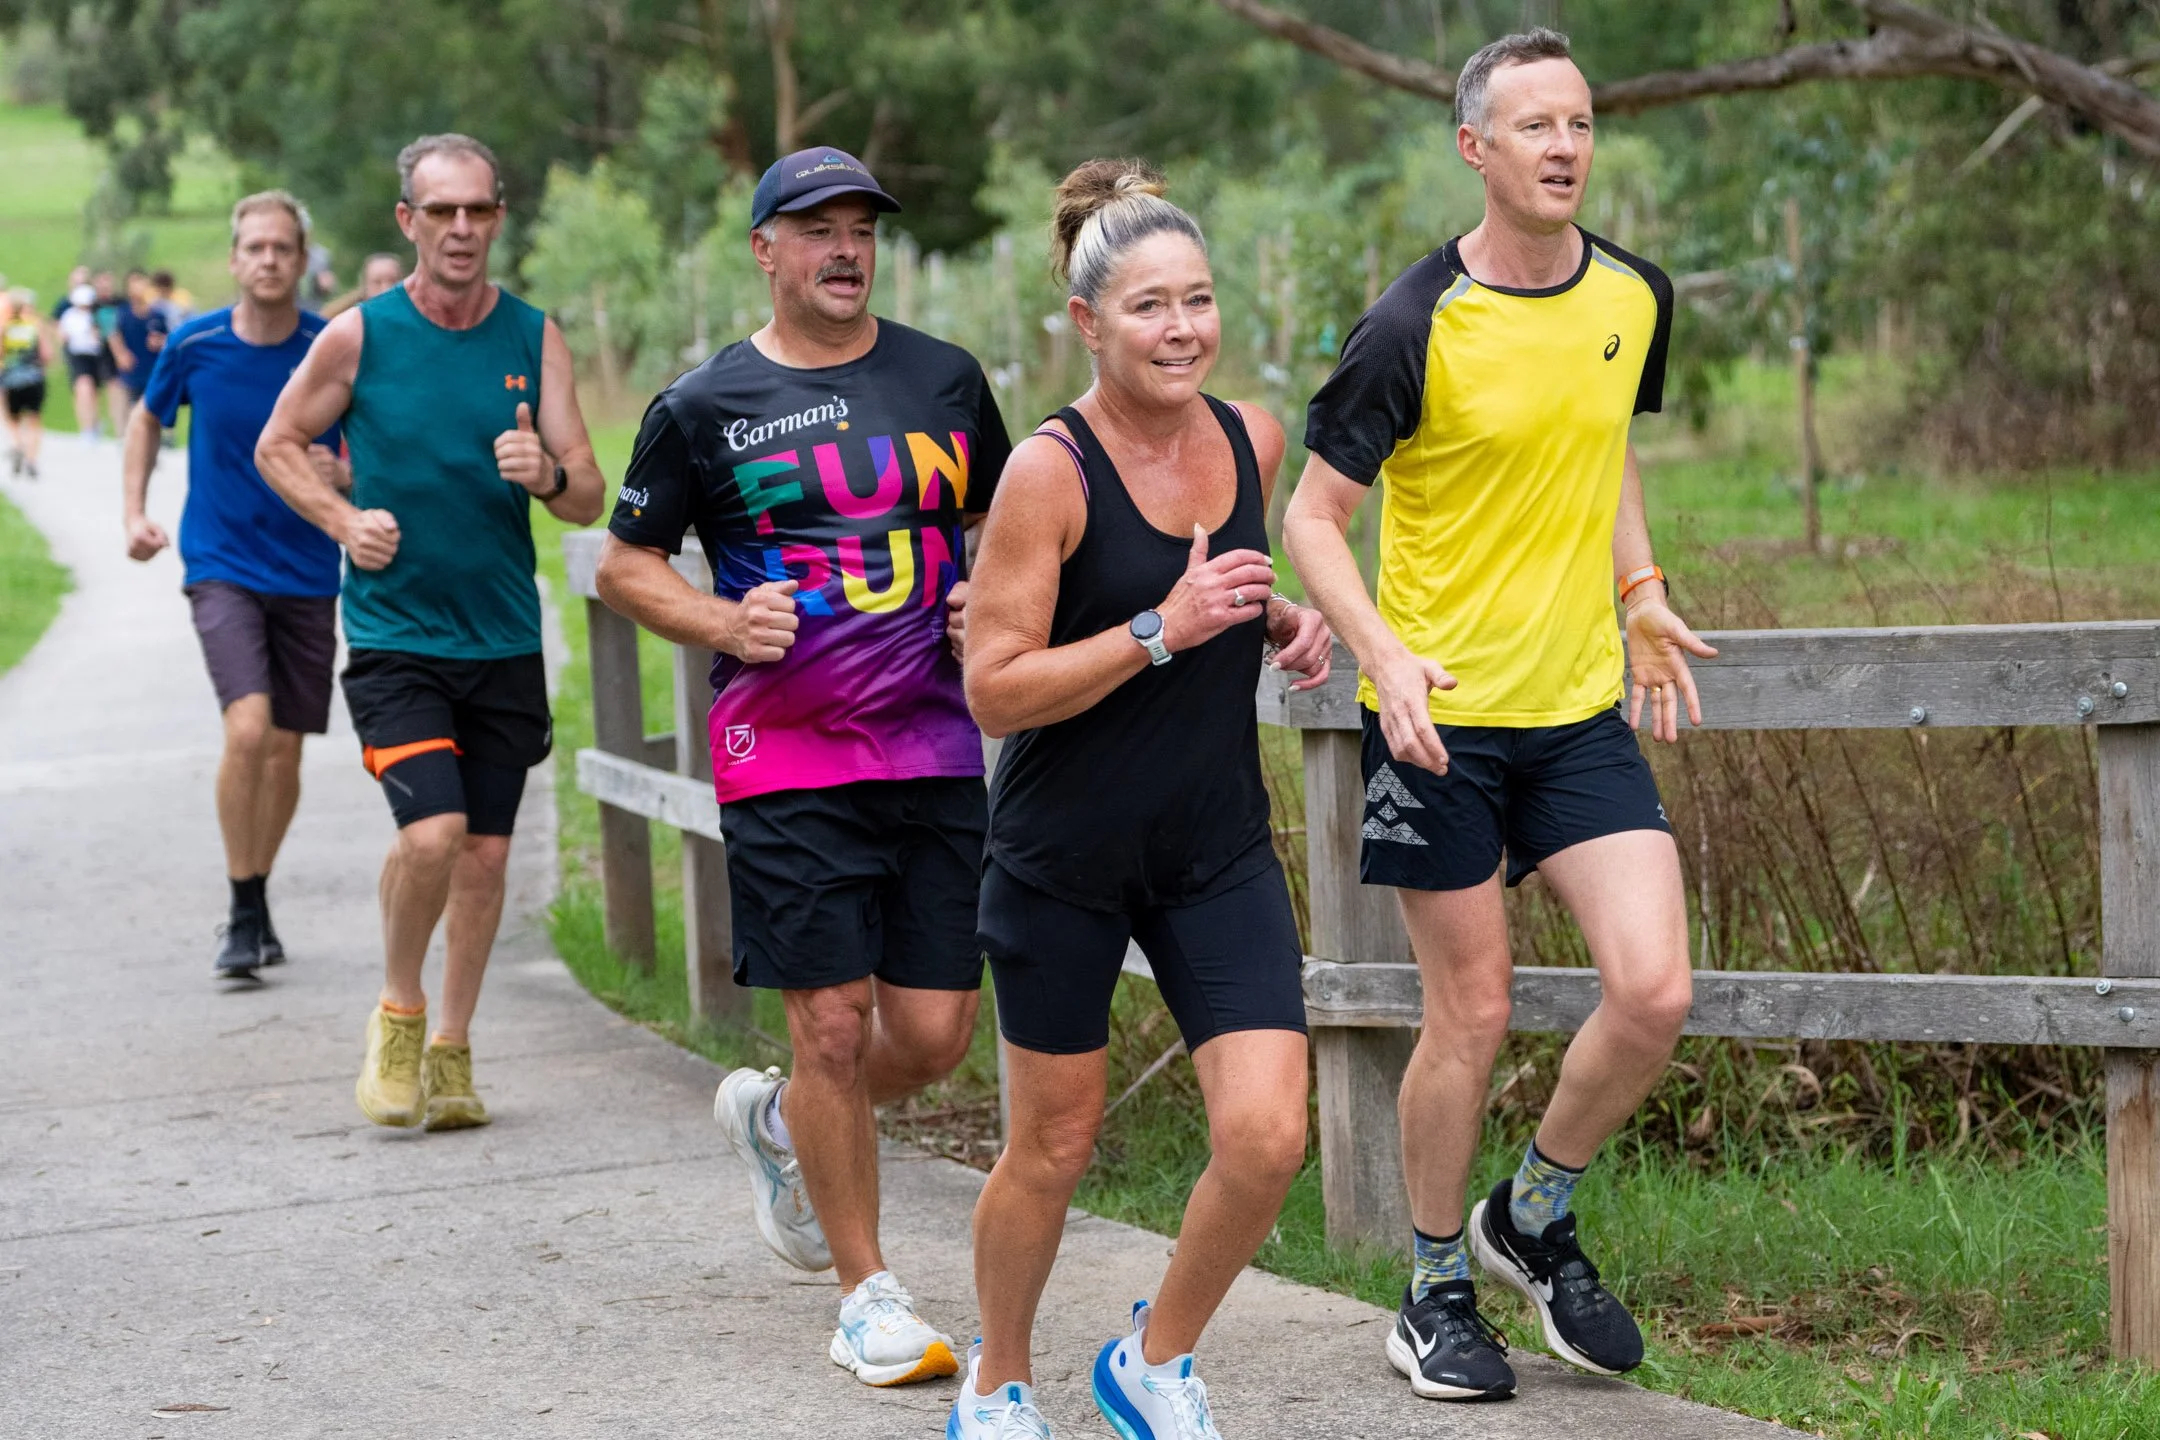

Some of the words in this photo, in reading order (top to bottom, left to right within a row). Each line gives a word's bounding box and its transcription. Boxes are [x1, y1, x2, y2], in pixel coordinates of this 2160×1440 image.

[722, 394, 849, 452] Carman's
[732, 431, 970, 537] FUN
[762, 523, 961, 616] RUN
